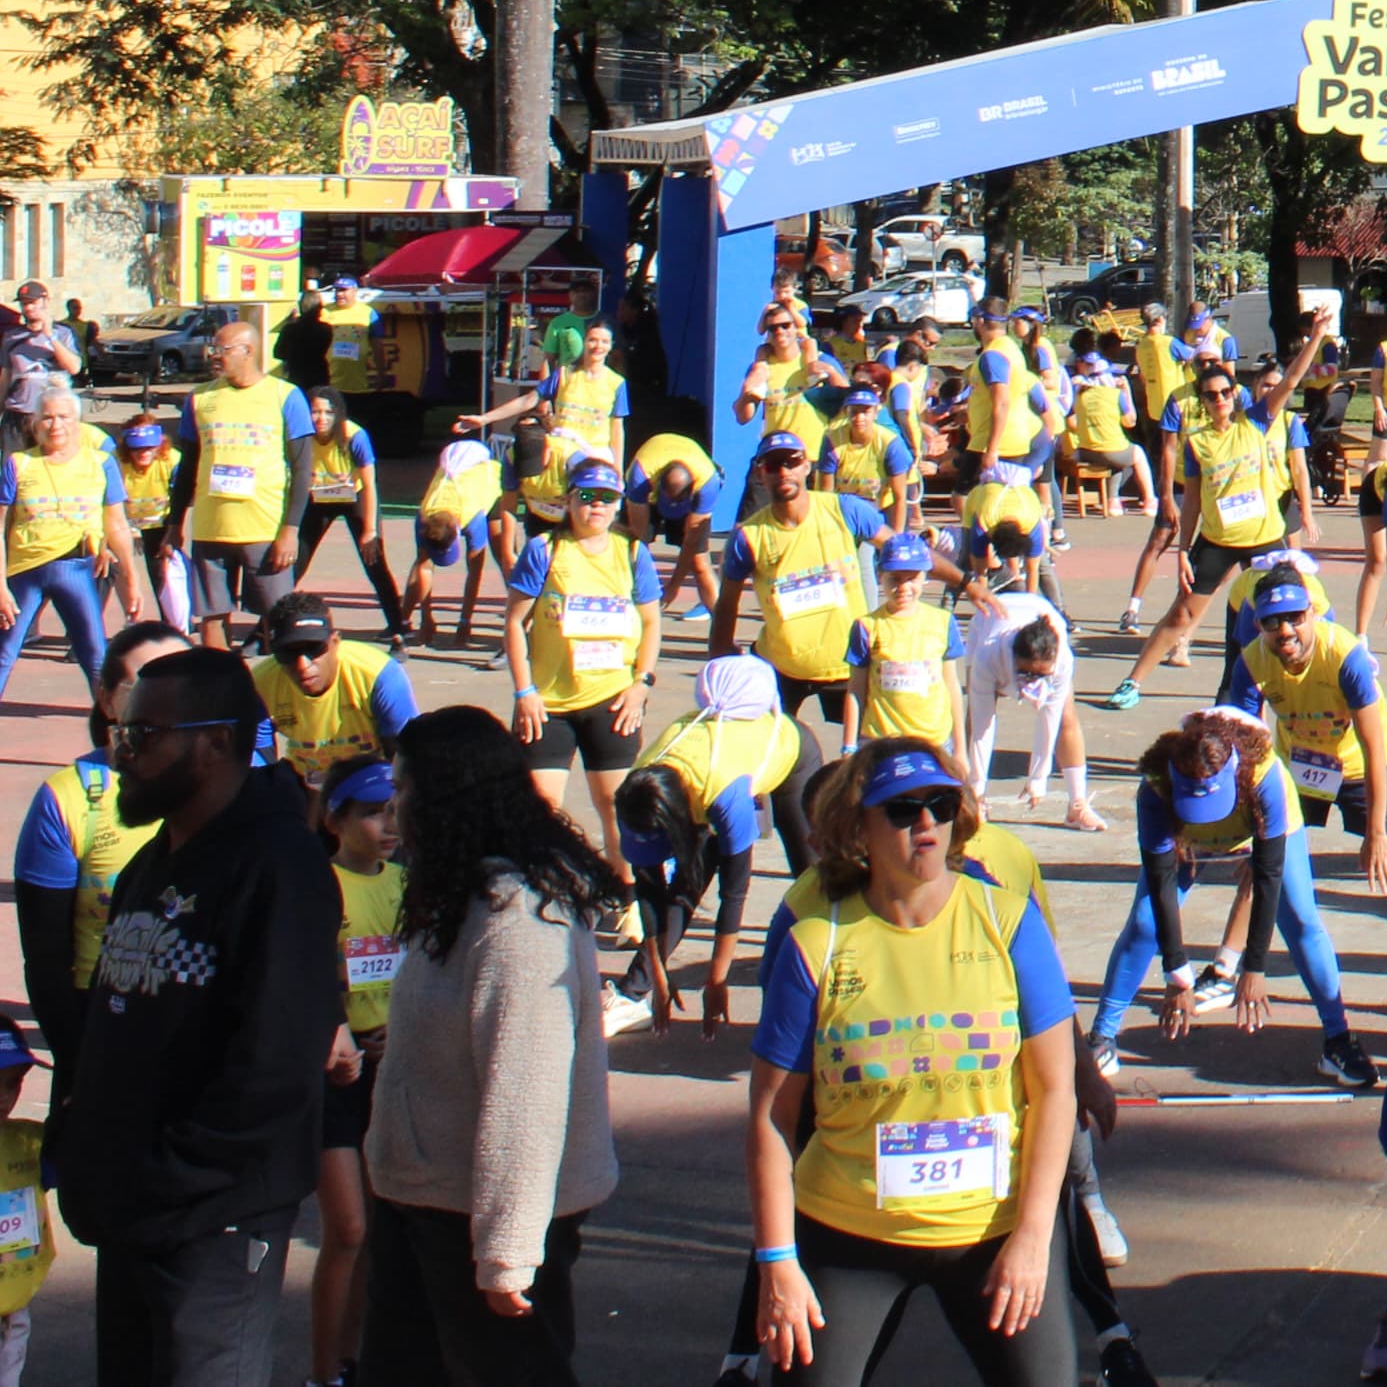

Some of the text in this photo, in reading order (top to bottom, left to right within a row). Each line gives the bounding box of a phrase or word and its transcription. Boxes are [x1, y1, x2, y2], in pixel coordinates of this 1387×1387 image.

[378, 100, 449, 135] AÇAÍ
[377, 135, 450, 159] SURF
[1303, 768, 1328, 784] 417
[361, 958, 393, 974] 2122
[910, 1157, 963, 1184] 381
